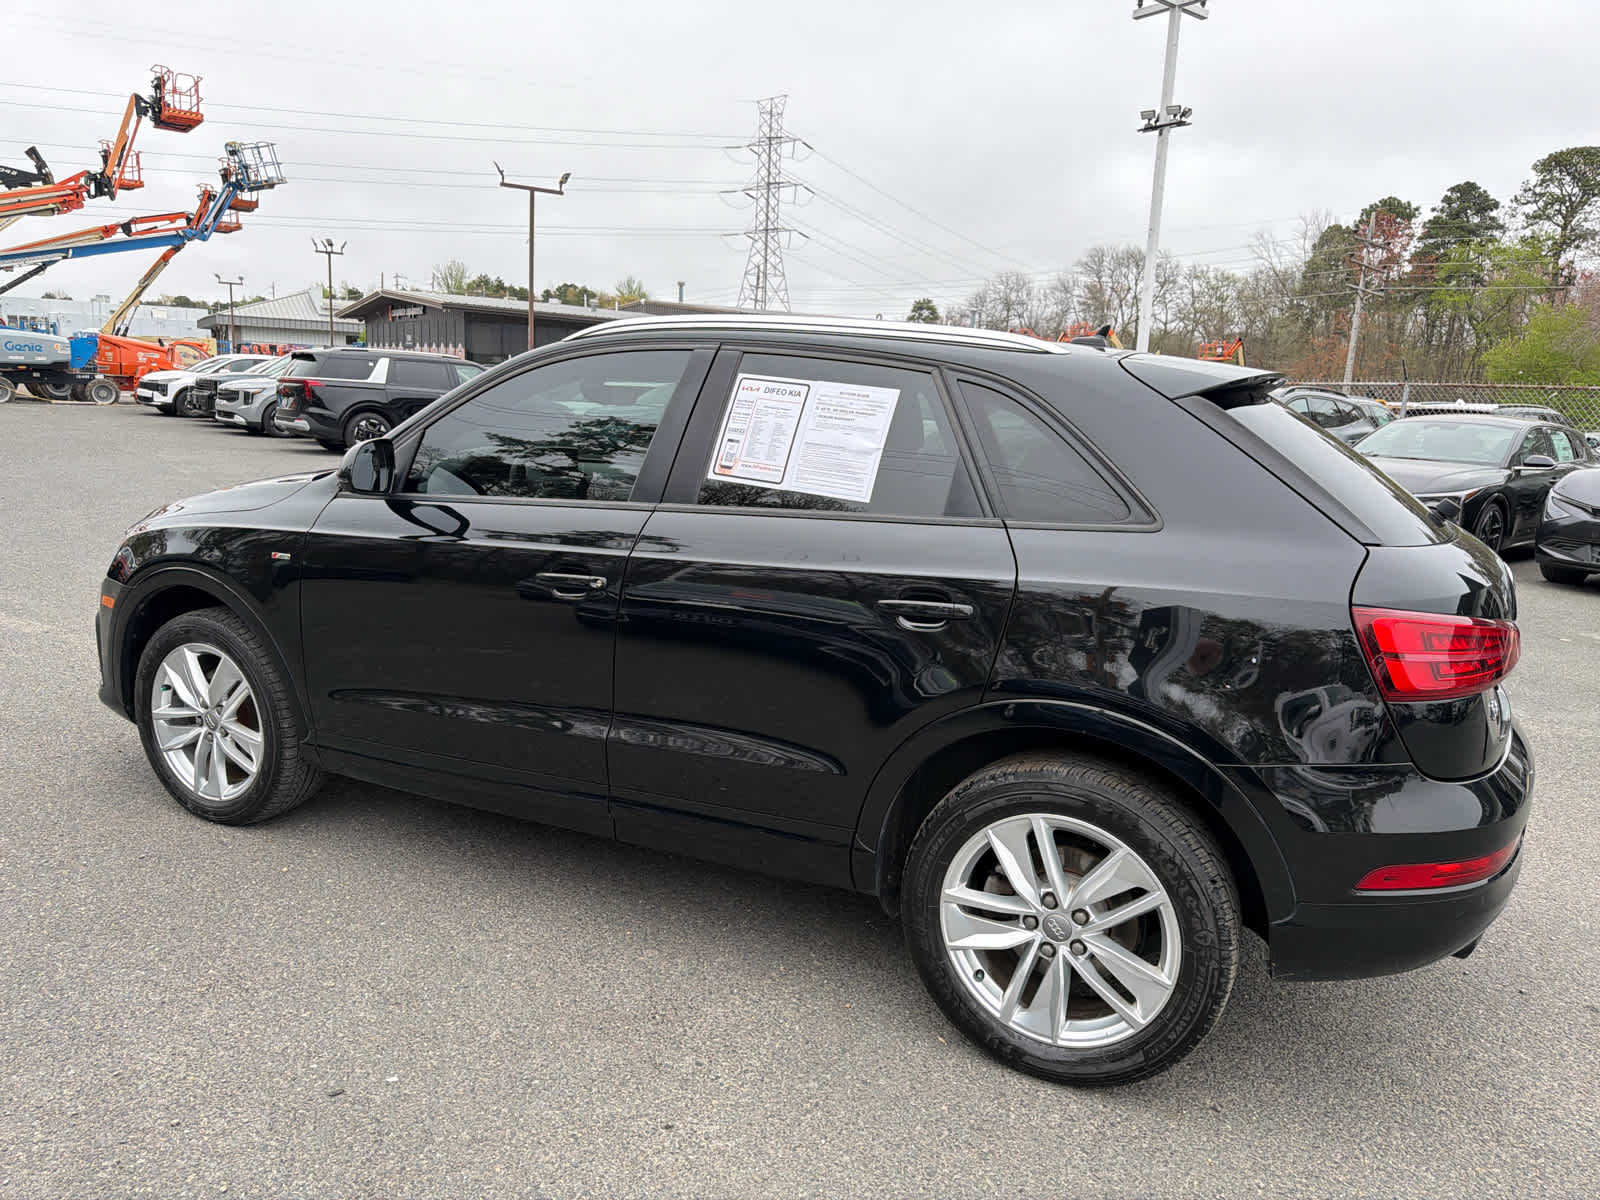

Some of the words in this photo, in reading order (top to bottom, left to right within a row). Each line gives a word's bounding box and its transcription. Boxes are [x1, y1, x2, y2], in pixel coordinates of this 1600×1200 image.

[4, 341, 43, 352] Genie
[763, 386, 787, 396] DIFEO
[788, 388, 801, 398] KIA
